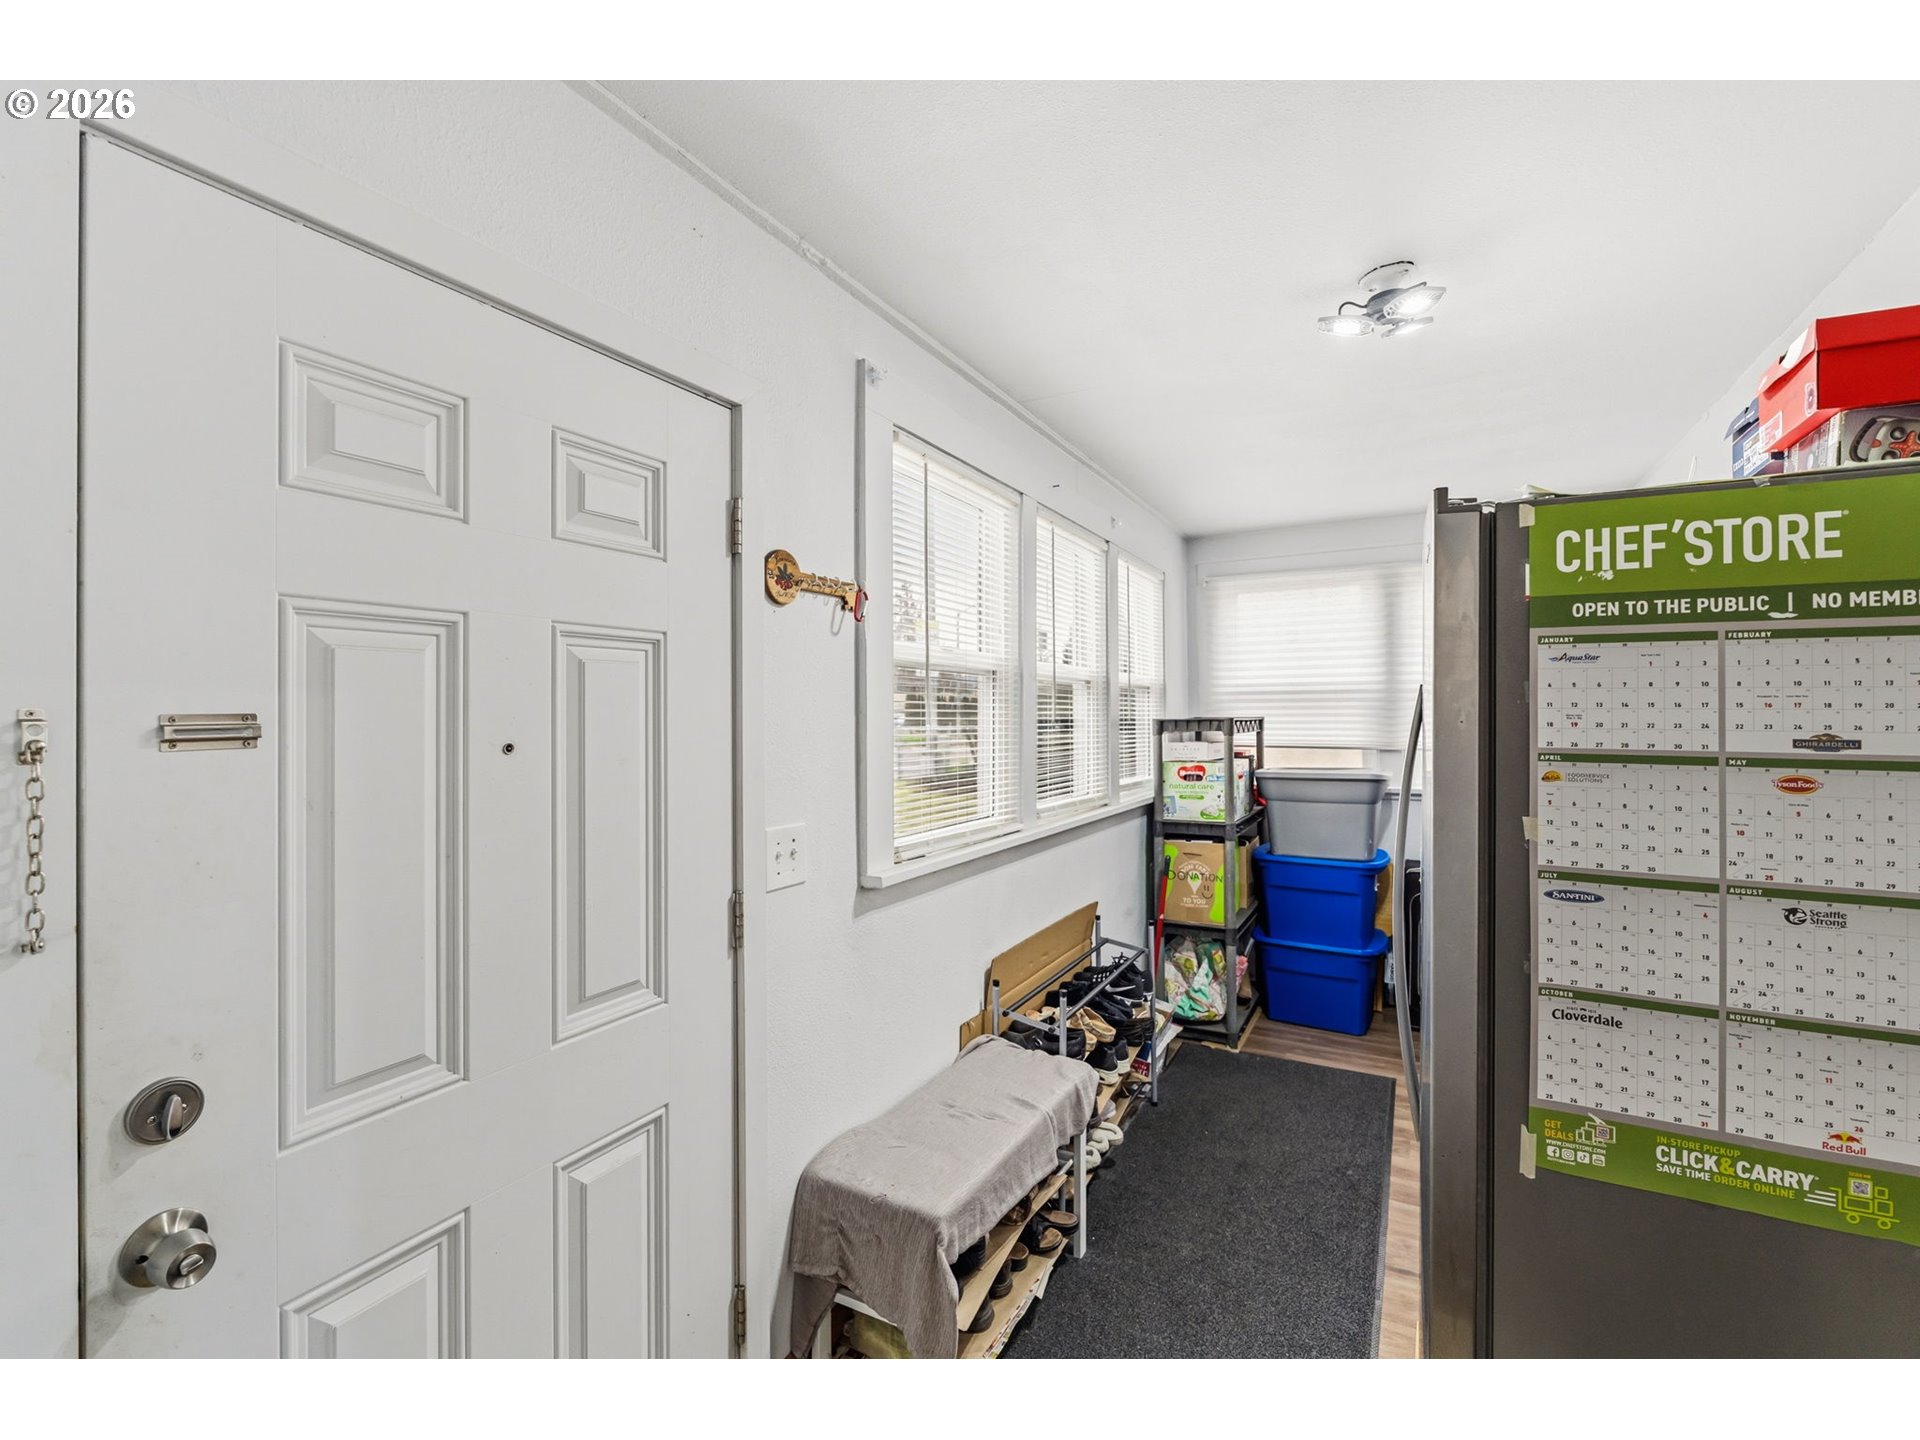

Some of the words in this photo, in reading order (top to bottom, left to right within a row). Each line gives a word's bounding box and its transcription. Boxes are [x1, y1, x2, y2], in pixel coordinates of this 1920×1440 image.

[1555, 510, 1843, 573] CHEF'STORE
[1572, 601, 1619, 618] OPEN
[1625, 600, 1649, 616] TO
[1654, 598, 1691, 615] THE
[1697, 595, 1770, 613] PUBLIC
[1812, 592, 1842, 609] NO
[1849, 589, 1920, 607] MEMB
[1540, 636, 1574, 644] JANUARY
[1728, 631, 1772, 639] FEBRUARY
[1795, 740, 1859, 749] GHIRARDELLI
[1772, 778, 1797, 789] Tyson
[1701, 827, 1710, 835] 18
[1736, 829, 1745, 837] 10
[1824, 834, 1834, 842] 13
[1886, 837, 1896, 845] 15
[1701, 848, 1710, 856] 25
[1824, 856, 1834, 864] 20
[1886, 860, 1896, 868] 22
[1552, 890, 1595, 902] SANTINI
[1729, 887, 1763, 896] AUGUST
[1809, 909, 1847, 920] Seattle
[1809, 917, 1847, 928] Strong
[1647, 968, 1656, 976] 23
[1825, 967, 1835, 975] 12
[1541, 988, 1574, 998] OCTOBER
[1758, 990, 1768, 998] 24
[1795, 986, 1804, 994] 18
[1855, 993, 1866, 1001] 20
[1551, 1008, 1623, 1029] Cloverdale
[1729, 1013, 1776, 1025] NOVEMBER
[1855, 1015, 1865, 1023] 27
[1674, 1074, 1682, 1082] 16
[1795, 1072, 1804, 1080] 10
[1855, 1081, 1864, 1089] 12
[1886, 1085, 1896, 1093] 13
[1646, 1090, 1655, 1098] 22
[1673, 1095, 1682, 1103] 23
[1765, 1089, 1774, 1097] 16
[1794, 1094, 1804, 1102] 17
[1855, 1103, 1864, 1111] 19
[1885, 1108, 1896, 1116] 20
[1544, 1119, 1562, 1129] GET
[1764, 1111, 1774, 1119] 23
[1794, 1116, 1804, 1124] 24
[1824, 1121, 1834, 1129] 25
[1885, 1130, 1895, 1138] 27
[1544, 1128, 1574, 1141] DEALS
[1764, 1132, 1774, 1140] 30
[1656, 1136, 1701, 1151] IN-STORE
[1703, 1144, 1741, 1158] PICKUP
[1822, 1141, 1843, 1153] Red
[1845, 1145, 1866, 1156] Bull
[1656, 1163, 1683, 1176] SAVE
[1684, 1168, 1711, 1182] TIME
[1713, 1175, 1750, 1189] ORDER
[1753, 1183, 1796, 1199] ONLINE
